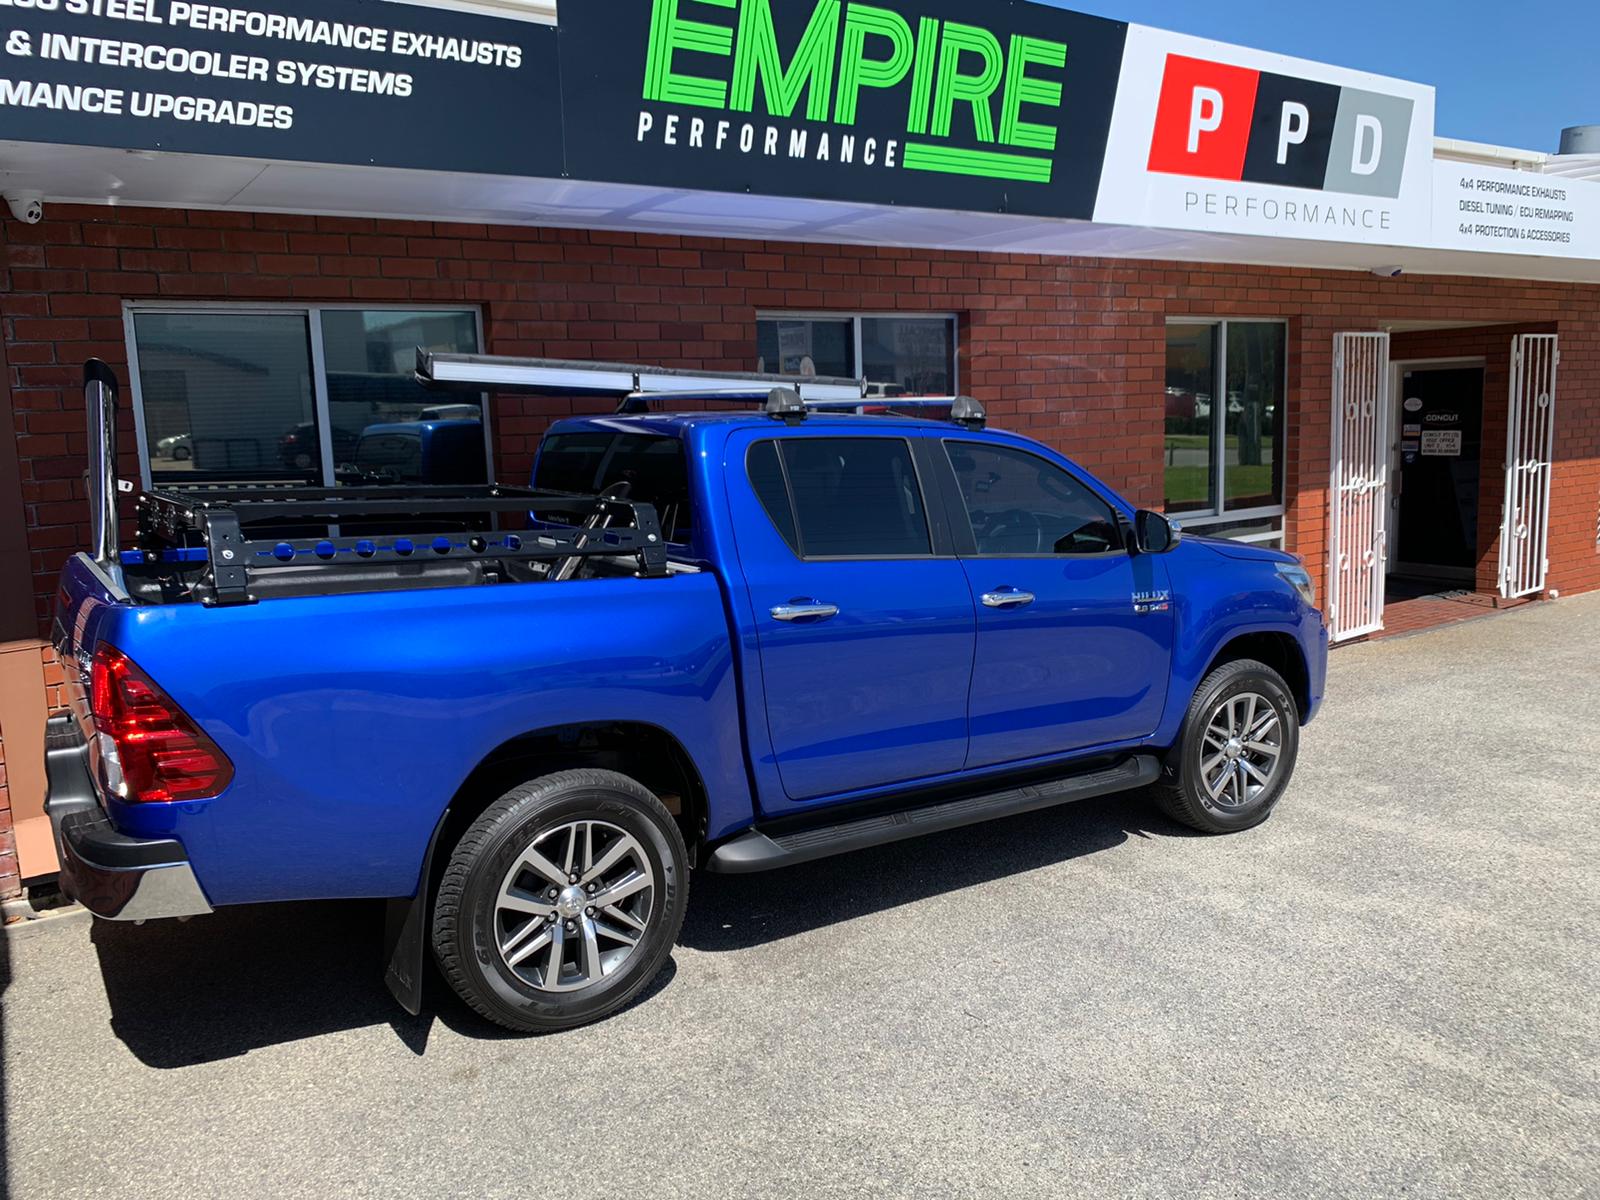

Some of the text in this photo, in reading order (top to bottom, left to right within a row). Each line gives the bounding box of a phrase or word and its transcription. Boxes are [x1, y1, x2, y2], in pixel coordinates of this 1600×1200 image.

[65, 0, 522, 68] STEEL PERFORMANCE EXHAUSTS
[5, 30, 413, 97] & INTERCOOLER SYSTEMS
[642, 0, 1067, 150] EMPIRE
[0, 78, 294, 130] MANCE UPGRADES
[637, 111, 898, 168] PERFORMANCE
[1185, 191, 1391, 230] PERFORMANCE
[1459, 199, 1484, 213] DIESEL
[1485, 202, 1513, 216] TUNING
[1519, 206, 1534, 218] ECU
[1534, 207, 1574, 222] REMAPPING
[1460, 177, 1567, 201] 4x4 PERFORMANCE EXHAUSTS
[1459, 223, 1571, 243] 4x4 PROTECTION & ACCESSORIES
[1131, 589, 1169, 603] HILUX
